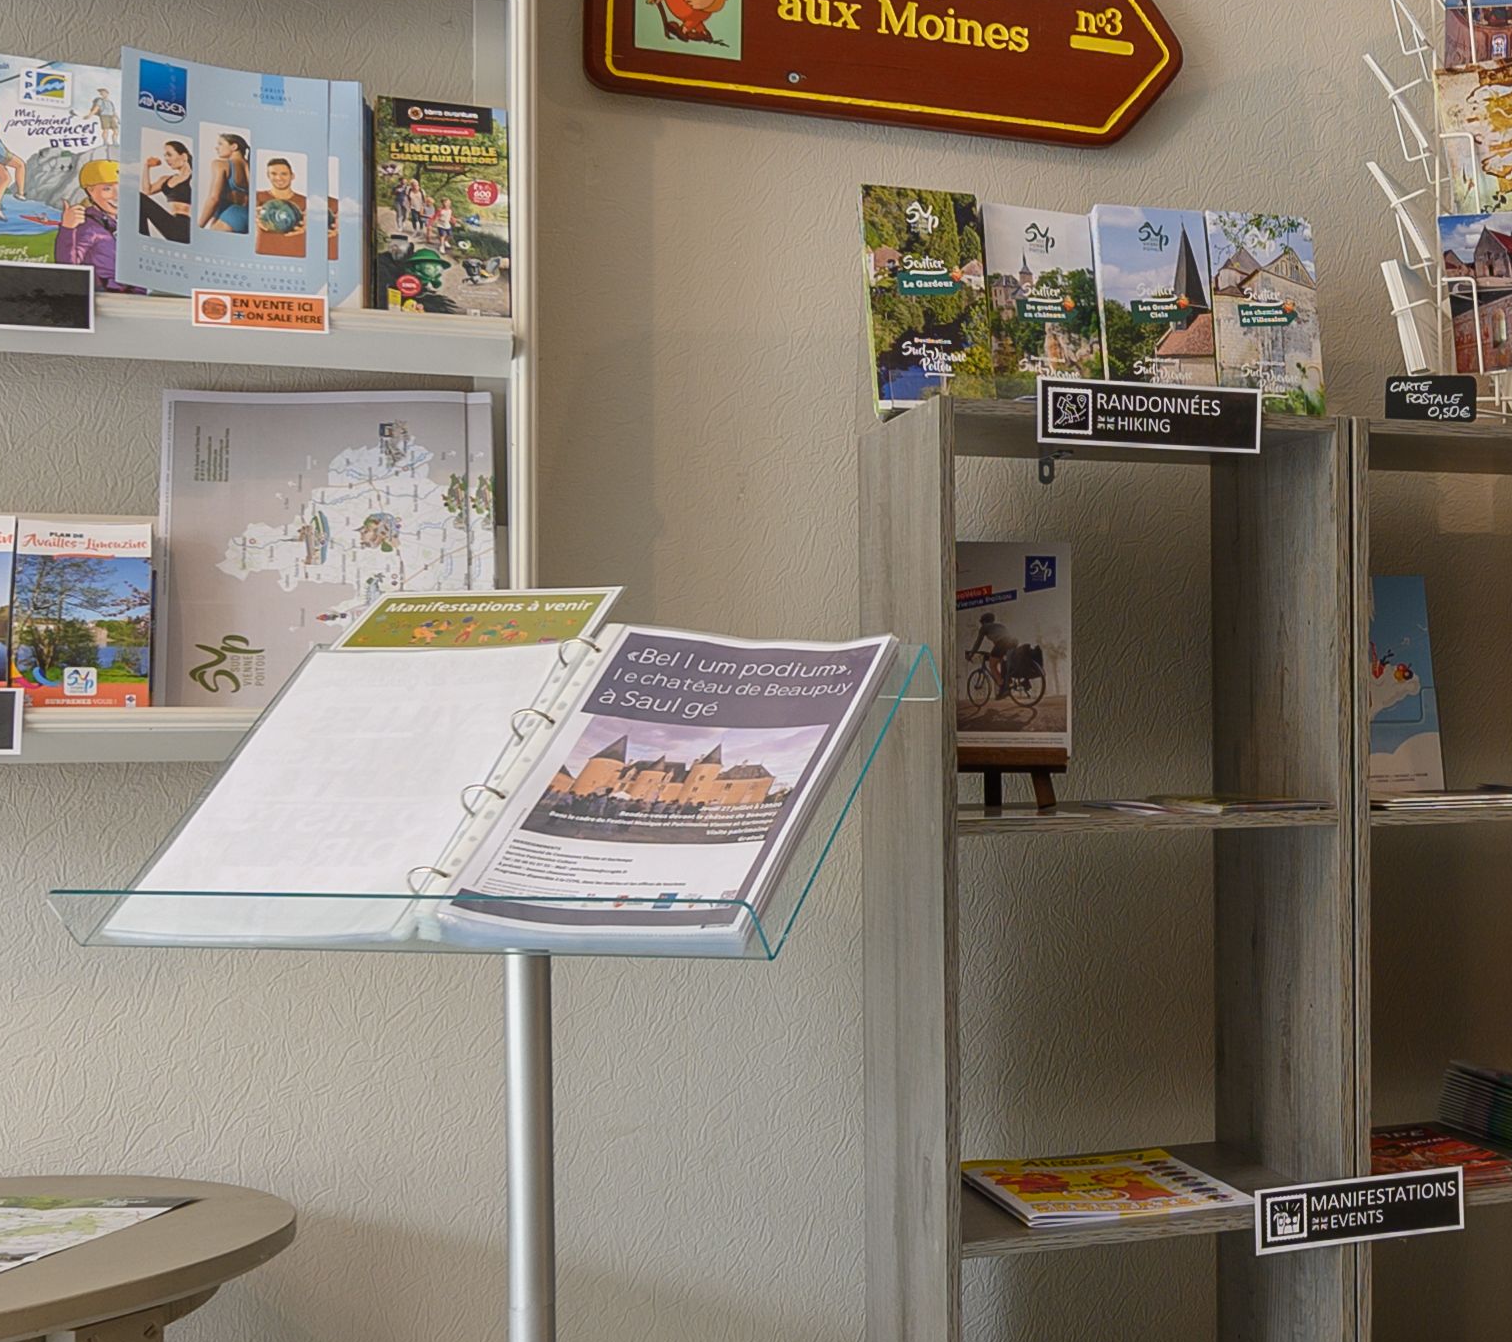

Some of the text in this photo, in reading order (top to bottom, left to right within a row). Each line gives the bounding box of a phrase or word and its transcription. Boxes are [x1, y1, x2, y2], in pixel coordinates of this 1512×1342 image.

[876, 0, 1029, 53] Moines
[27, 122, 98, 137] vacances
[390, 142, 497, 157] L'INCROYABLE
[903, 279, 914, 288] Le
[232, 298, 313, 312] EN VENTE ICI
[246, 312, 323, 325] ON SALE HERE
[1390, 380, 1433, 394] CARTE
[1097, 392, 1221, 417] RANDONNÉES
[1406, 392, 1464, 406] POSTALE
[1427, 406, 1471, 420] 0,50€
[1117, 416, 1171, 434] HIKING
[385, 597, 594, 615] Manifestations à venir
[735, 680, 853, 698] de Beaupuy
[1310, 1180, 1457, 1213] MANIFESTATIONS
[1329, 1209, 1385, 1228] EVENTS
